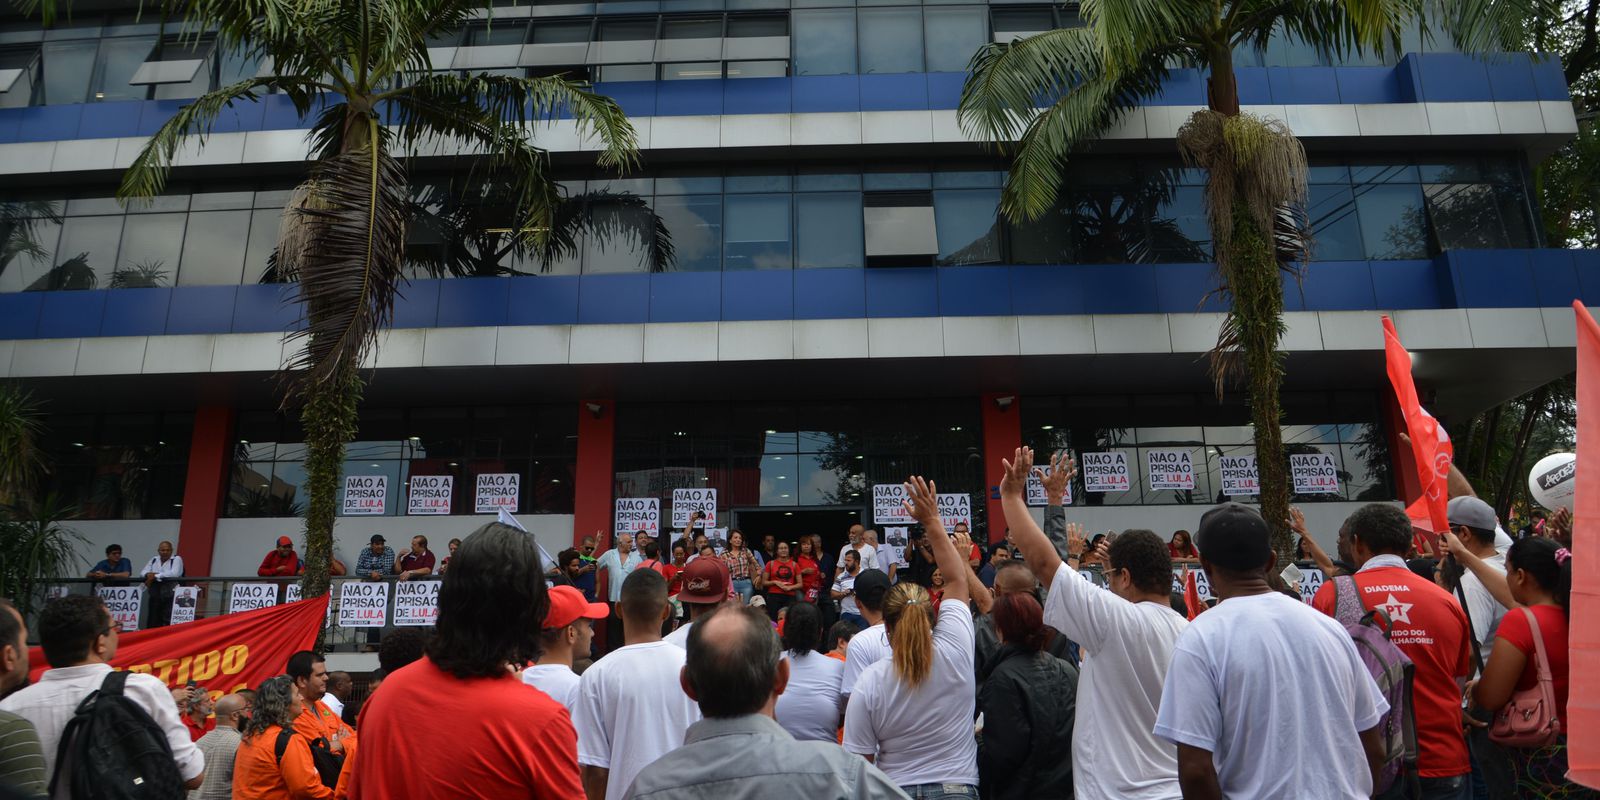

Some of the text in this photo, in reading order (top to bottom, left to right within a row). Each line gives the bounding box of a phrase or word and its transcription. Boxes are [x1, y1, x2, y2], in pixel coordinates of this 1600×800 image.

[1086, 476, 1127, 484] DE LULA
[1152, 474, 1192, 482] DE LULA
[1295, 478, 1336, 486] DE LULA
[1224, 480, 1236, 488] DE
[1028, 490, 1041, 498] DE
[345, 499, 383, 508] DE LULA
[410, 499, 448, 508] DE LULA
[476, 497, 516, 506] DE LULA
[937, 496, 954, 506] AO
[632, 522, 657, 530] LULA
[1364, 585, 1410, 593] DIADEMA
[341, 610, 384, 619] DE LULA
[396, 608, 409, 618] DE
[1386, 605, 1402, 616] PT
